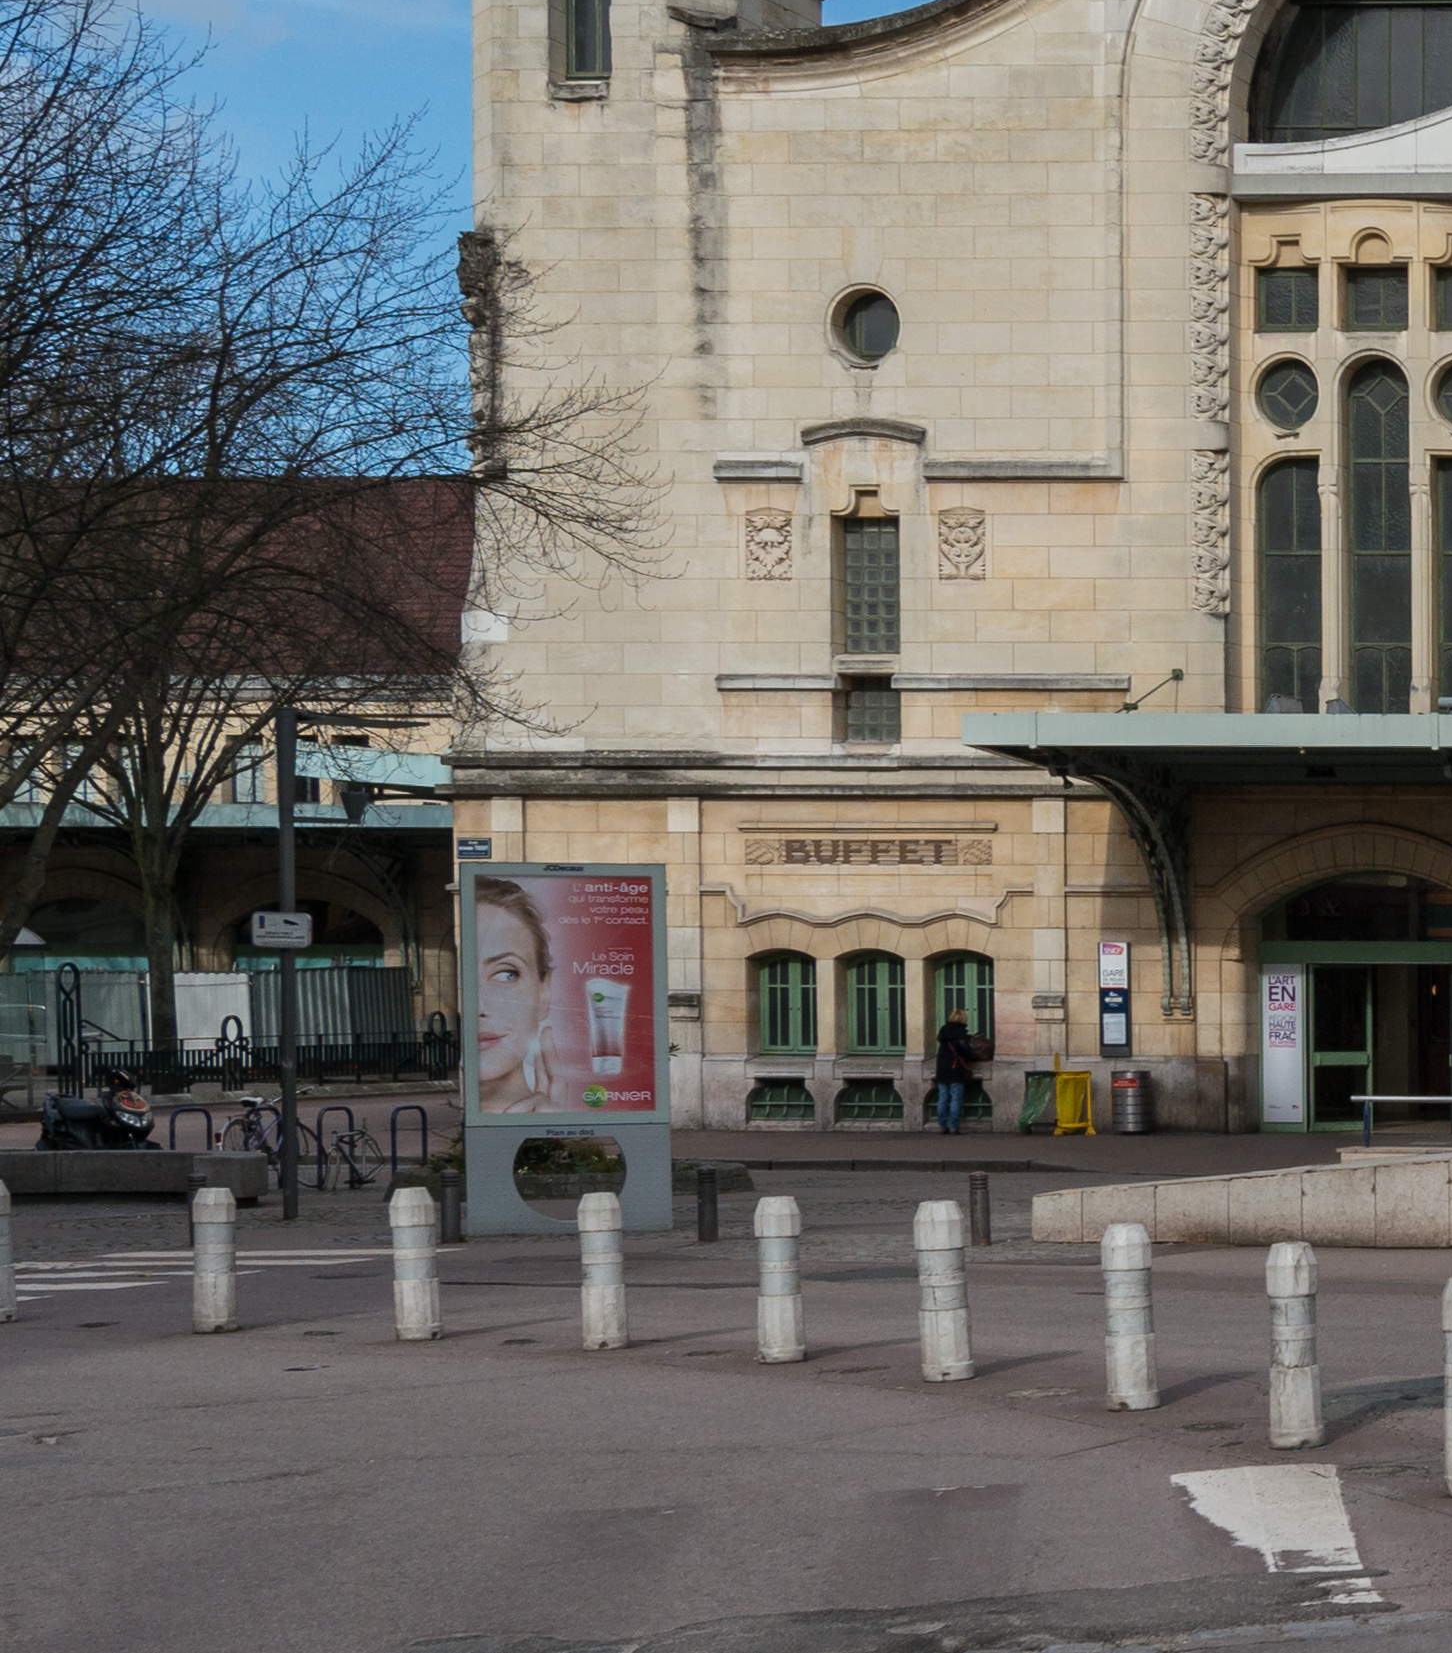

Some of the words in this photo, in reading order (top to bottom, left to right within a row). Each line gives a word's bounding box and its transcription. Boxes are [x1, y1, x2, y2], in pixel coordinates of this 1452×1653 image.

[785, 840, 952, 864] BUFFET
[585, 882, 648, 894] anti-âge
[588, 894, 648, 903] transforme
[590, 906, 617, 914] votre
[620, 907, 649, 916] peau
[592, 951, 606, 961] Le
[609, 951, 634, 961] Soin
[573, 961, 634, 975] Miracle
[1103, 969, 1125, 977] GARE
[1268, 976, 1295, 985] L'ART
[1268, 986, 1296, 1002] EN
[1269, 1003, 1296, 1011] GARE
[1269, 1032, 1296, 1040] FRAC
